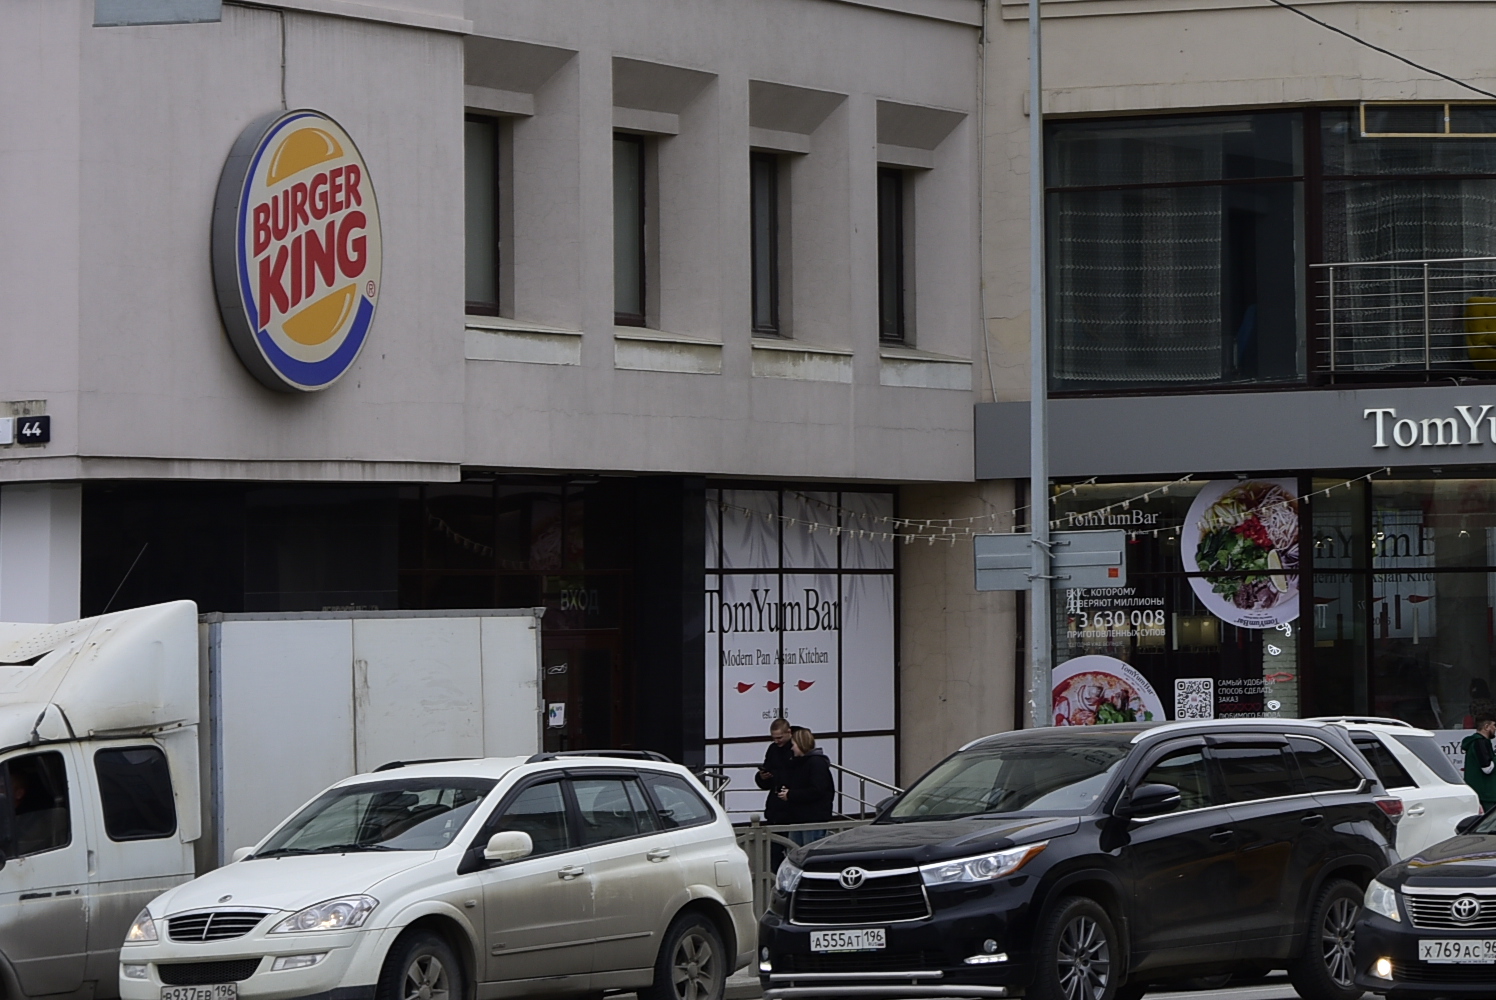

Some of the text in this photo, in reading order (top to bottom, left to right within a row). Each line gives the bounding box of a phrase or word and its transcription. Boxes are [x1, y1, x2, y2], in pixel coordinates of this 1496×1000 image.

[253, 164, 362, 258] BURGER
[259, 210, 367, 330] KING
[22, 422, 42, 437] 44
[1091, 588, 1136, 597] КОТОРОМУ
[560, 589, 600, 615] ВХОД
[1113, 598, 1165, 608] МИЛЛИОНЫ
[705, 588, 839, 633] TomYumBar
[1079, 609, 1165, 628] 3 630 008
[1066, 628, 1166, 638] ПРИГОТОВЛЕННЫХ СУПОВ
[722, 650, 753, 666] Modern
[756, 649, 771, 665] Pan
[799, 647, 829, 664] Kitchen
[1218, 678, 1242, 687] САМЫЙ
[1218, 687, 1273, 695] СПОСОБ СДЕЛАТЬ
[863, 930, 882, 942] 196
[215, 985, 233, 997] 196
